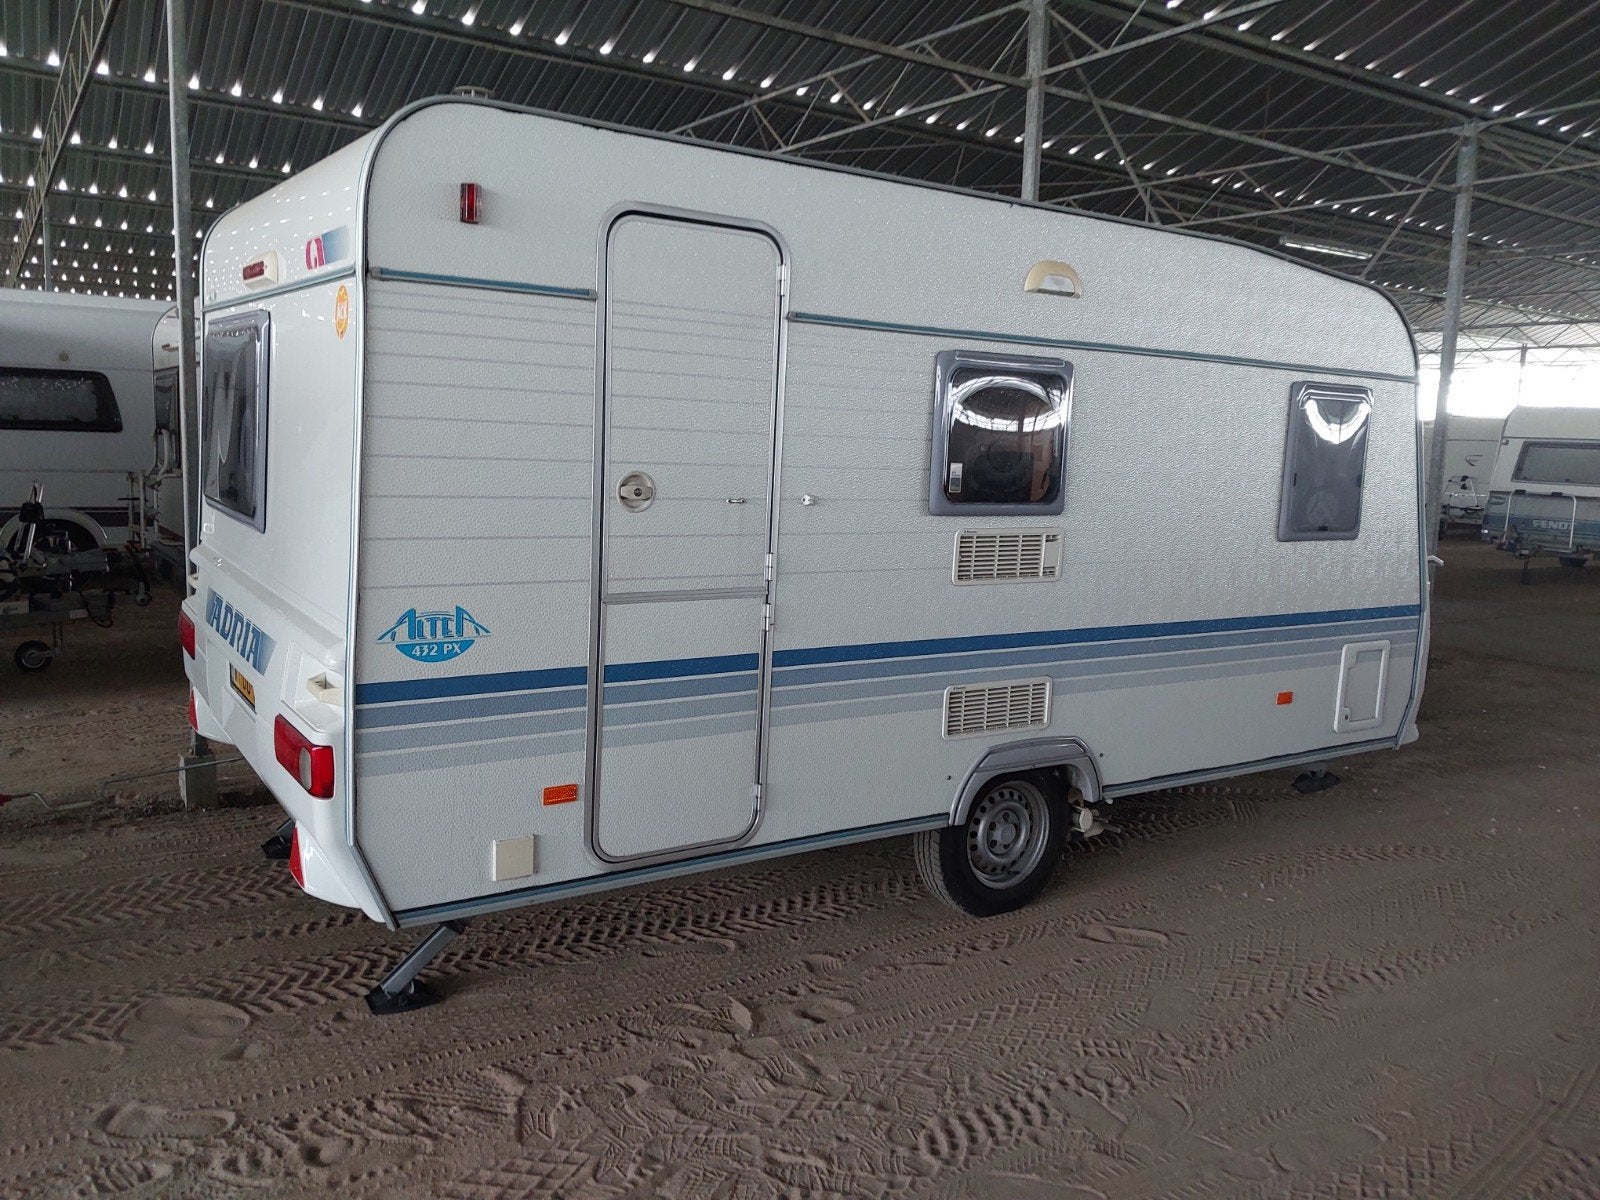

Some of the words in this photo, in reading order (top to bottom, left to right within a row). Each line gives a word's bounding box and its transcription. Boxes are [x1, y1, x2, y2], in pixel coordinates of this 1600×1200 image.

[210, 594, 262, 672] ADRIA
[377, 604, 491, 642] ALTEA
[411, 645, 438, 657] 432
[443, 643, 462, 656] PX
